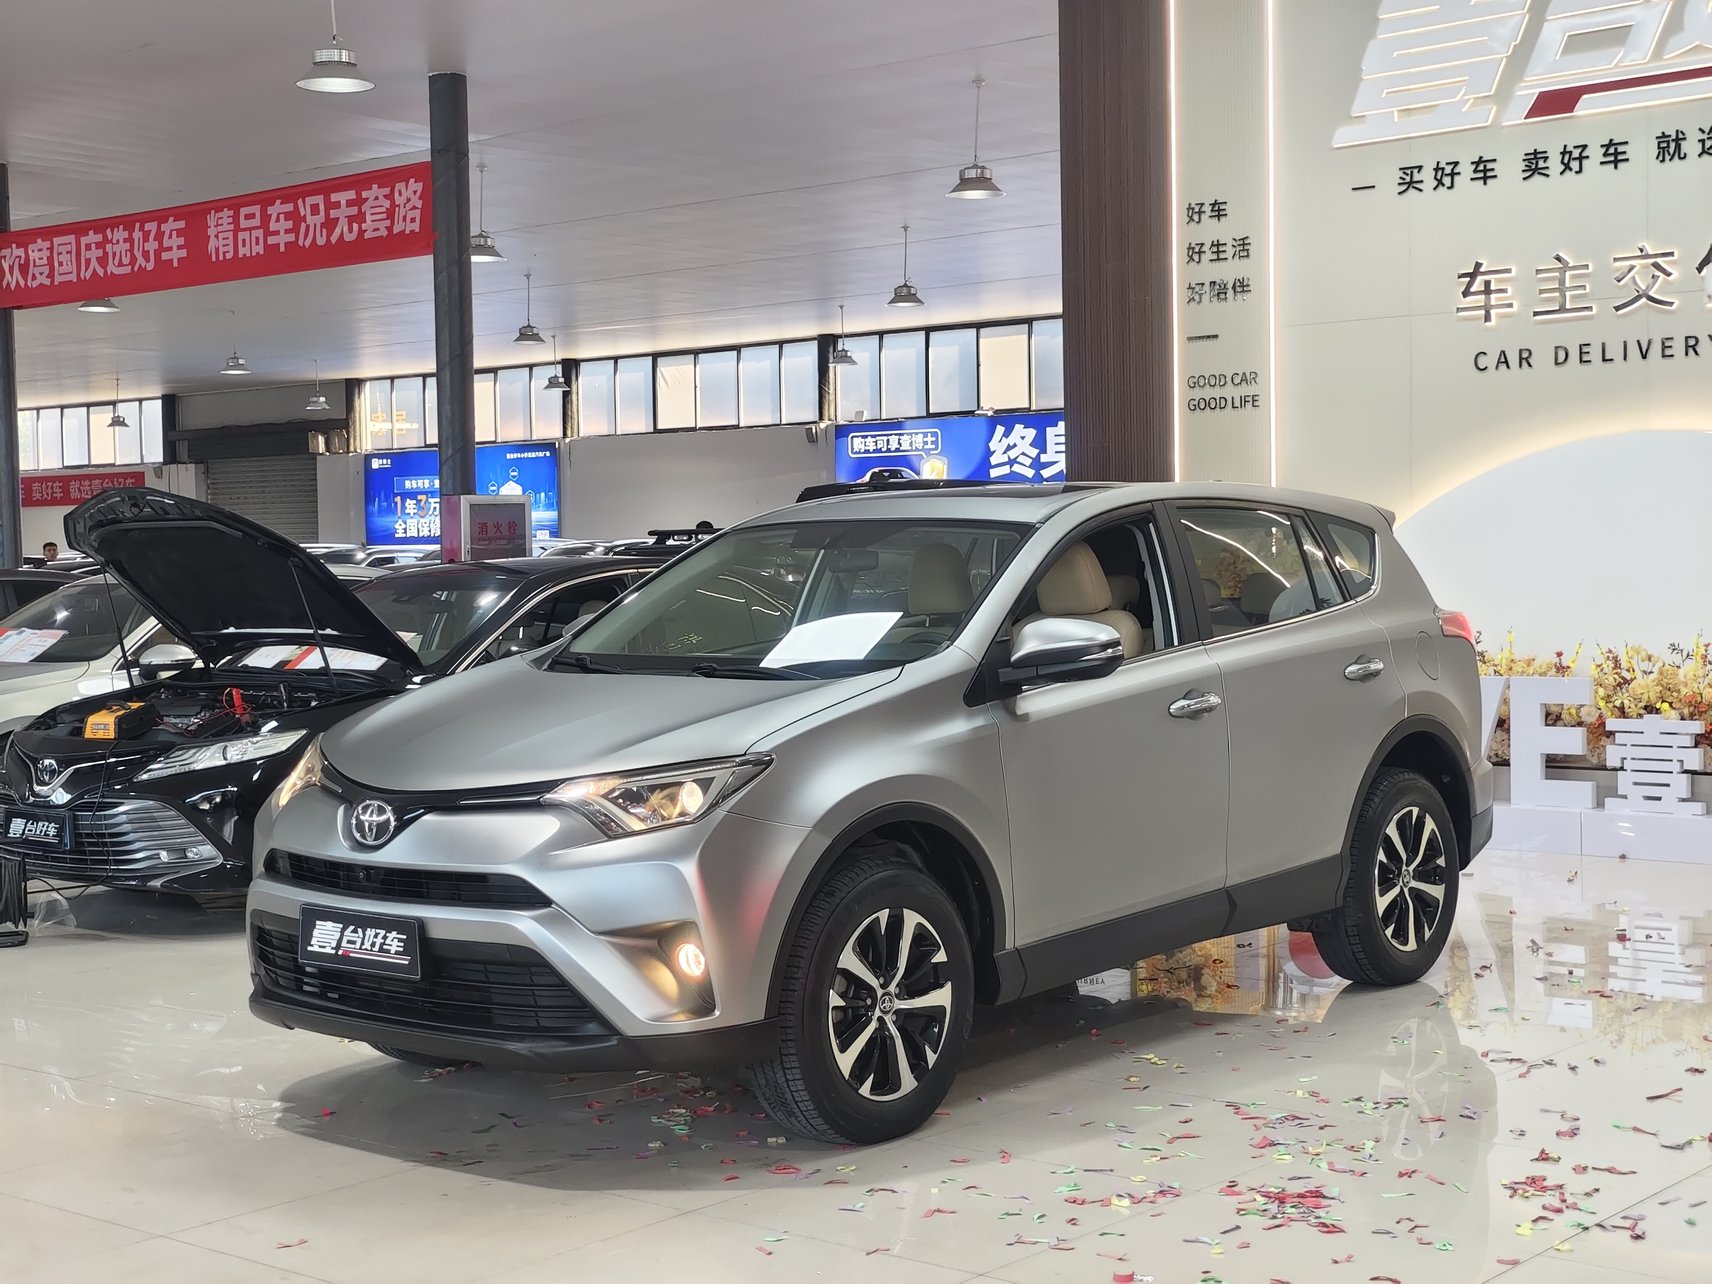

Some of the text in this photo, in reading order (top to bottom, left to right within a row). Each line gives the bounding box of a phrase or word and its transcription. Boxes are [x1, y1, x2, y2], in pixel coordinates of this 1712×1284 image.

[1331, 0, 1712, 148] 壹台
[1397, 154, 1498, 195] 买好车
[1521, 137, 1630, 181] 卖好车
[1186, 199, 1228, 225] 好车
[1, 177, 424, 291] 欢度国庆选好车 精品车况无套路
[1186, 235, 1252, 265] 好生活
[1186, 276, 1252, 304] 好陪伴
[1474, 347, 1534, 373] CAR
[1187, 371, 1259, 389] GOOD CAR
[1187, 394, 1260, 412] GOOD LIFE
[852, 433, 937, 453] 购车可享查博士
[478, 521, 518, 536] 消火栓
[1604, 714, 1707, 815] 壹
[7, 817, 60, 838] 壹台好车
[307, 920, 408, 954] 壹台好车
